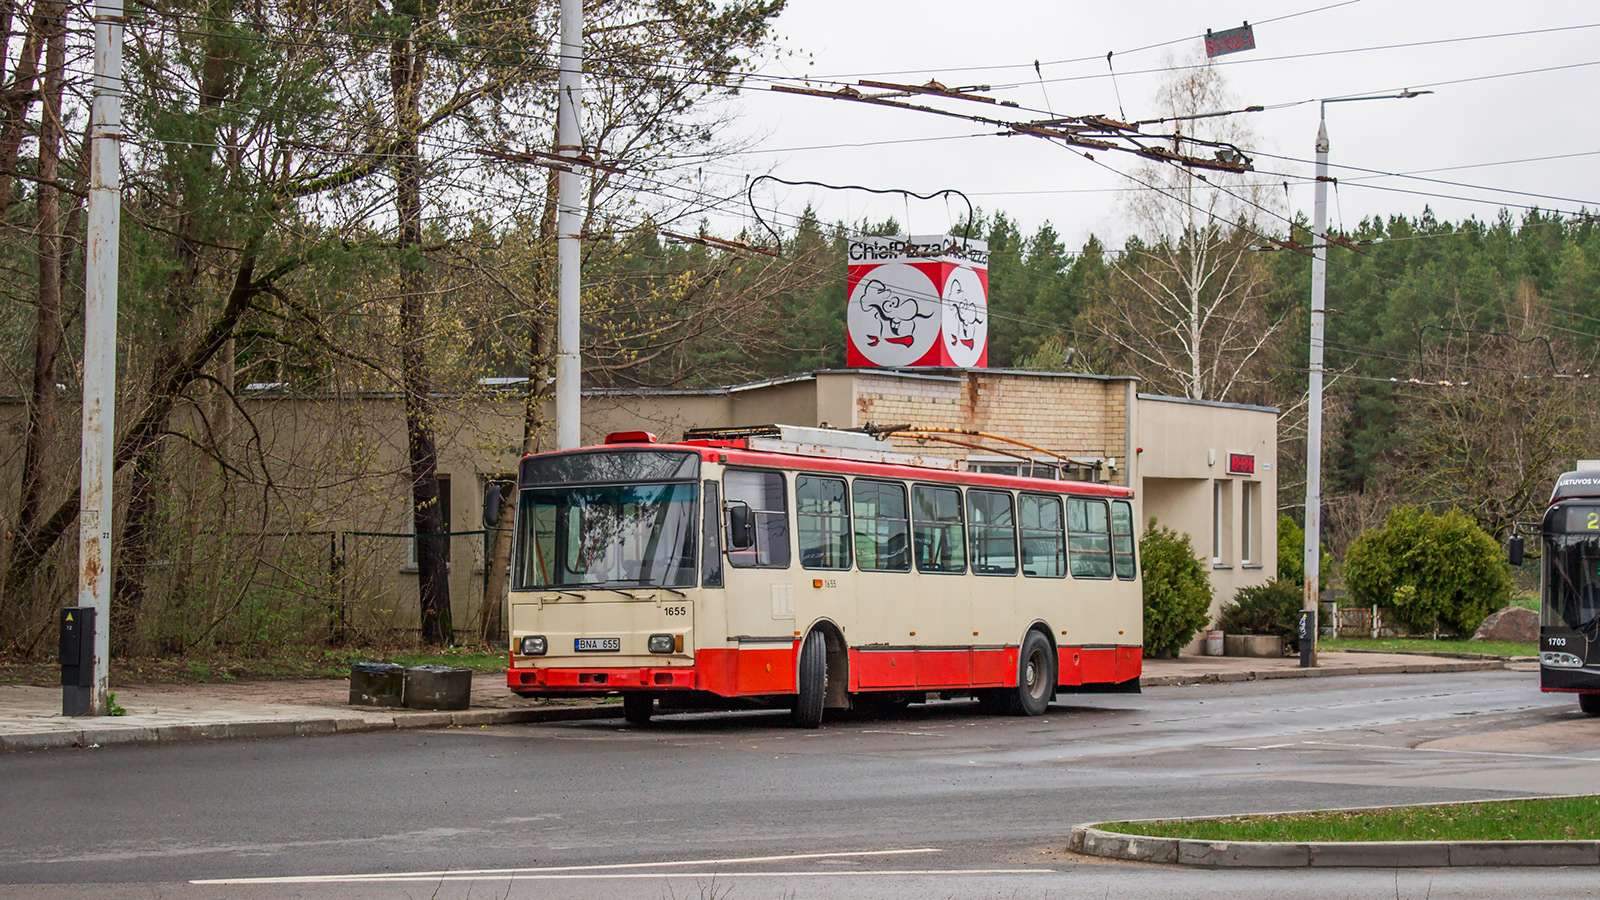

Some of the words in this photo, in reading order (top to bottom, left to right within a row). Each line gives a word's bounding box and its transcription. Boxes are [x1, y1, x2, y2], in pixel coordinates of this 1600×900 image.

[849, 240, 941, 260] ChiefPzza
[1560, 478, 1592, 486] LIETUVOS
[824, 579, 836, 588] 1655
[664, 606, 686, 616] 1655
[580, 640, 597, 649] BNA
[602, 640, 618, 649] 655
[1548, 637, 1567, 646] 1703
